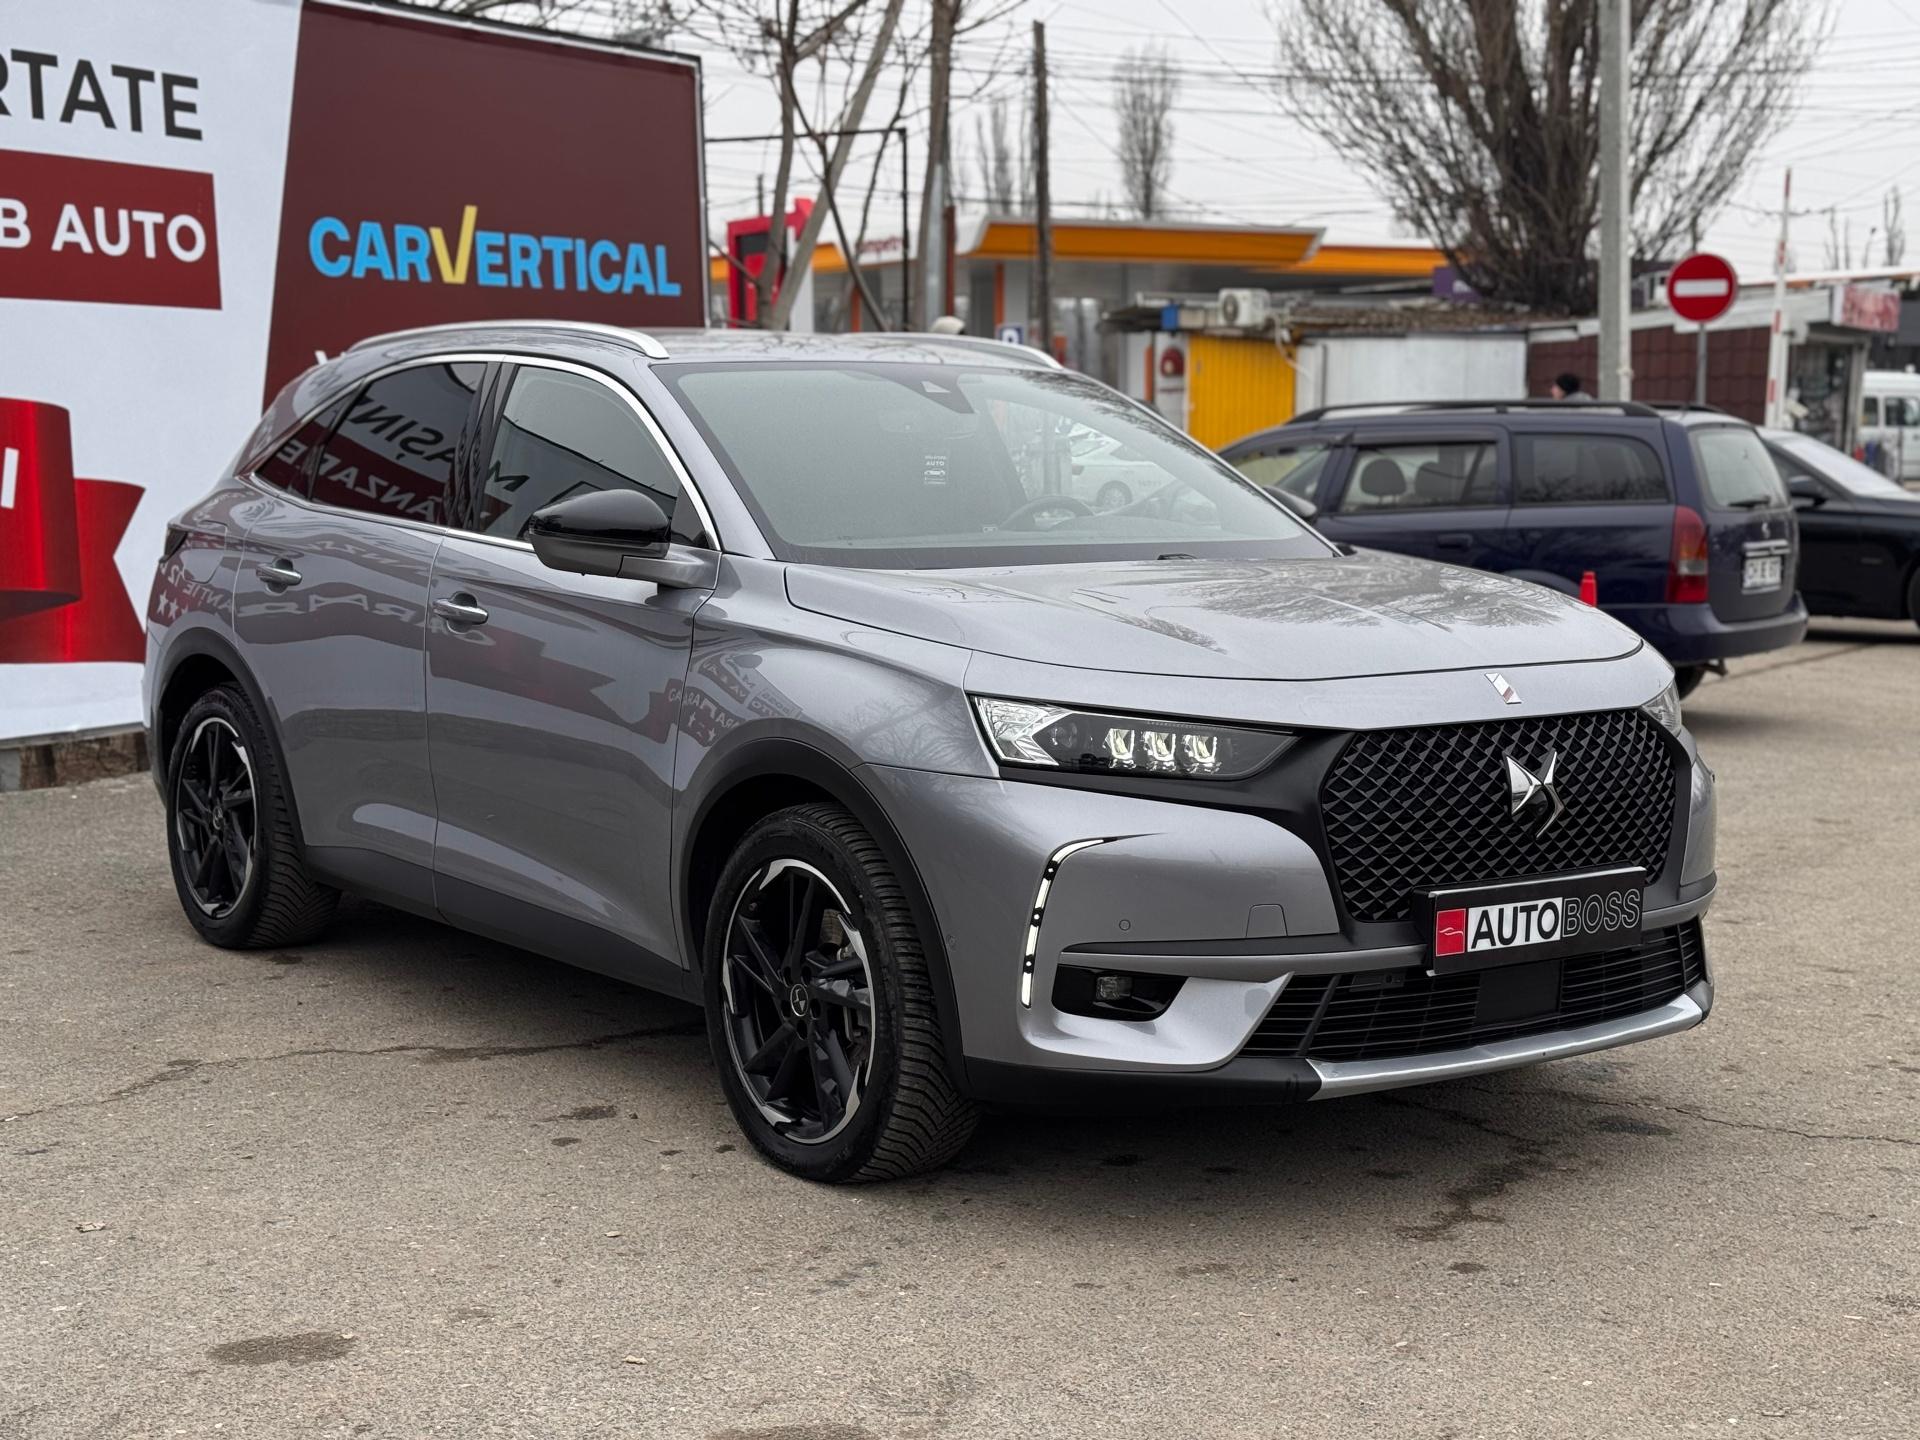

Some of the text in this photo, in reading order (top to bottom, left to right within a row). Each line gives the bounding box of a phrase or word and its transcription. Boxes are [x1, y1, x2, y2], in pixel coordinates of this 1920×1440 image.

[0, 48, 203, 141] TATE
[51, 203, 206, 263] AUTO
[308, 205, 682, 297] CARVERTICAL
